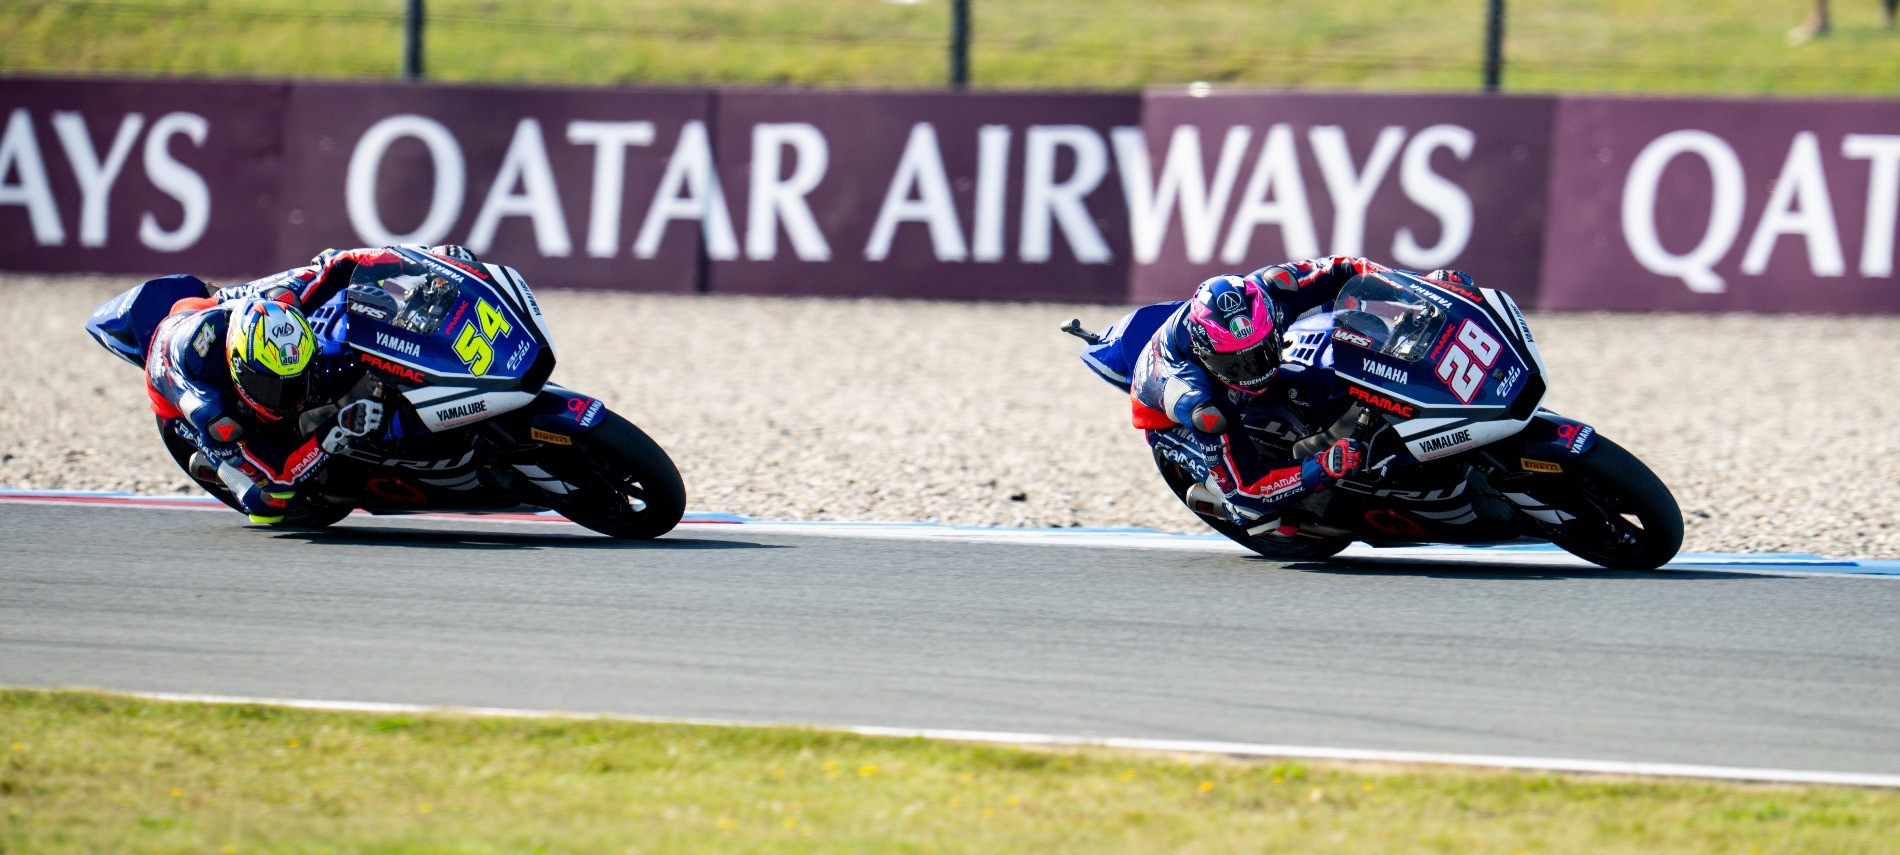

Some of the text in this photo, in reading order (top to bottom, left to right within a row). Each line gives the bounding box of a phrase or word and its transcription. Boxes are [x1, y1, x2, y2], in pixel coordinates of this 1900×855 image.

[345, 114, 1475, 268] QATAR AIRWAYS
[350, 302, 387, 319] WRS
[193, 322, 216, 358] 54
[375, 331, 421, 358] YAMAHA
[452, 297, 513, 378] 54
[1333, 330, 1371, 348] WRS
[1430, 323, 1456, 360] PRAMAC
[361, 354, 426, 384] PRAMAC
[1362, 358, 1408, 385] YAMAHA
[1434, 317, 1503, 406] 28
[1239, 367, 1277, 386] ESDEMARCA
[436, 400, 487, 421] YAMALUBE
[1349, 386, 1413, 418] PRAMAC
[1419, 429, 1471, 453] YAMALUBE
